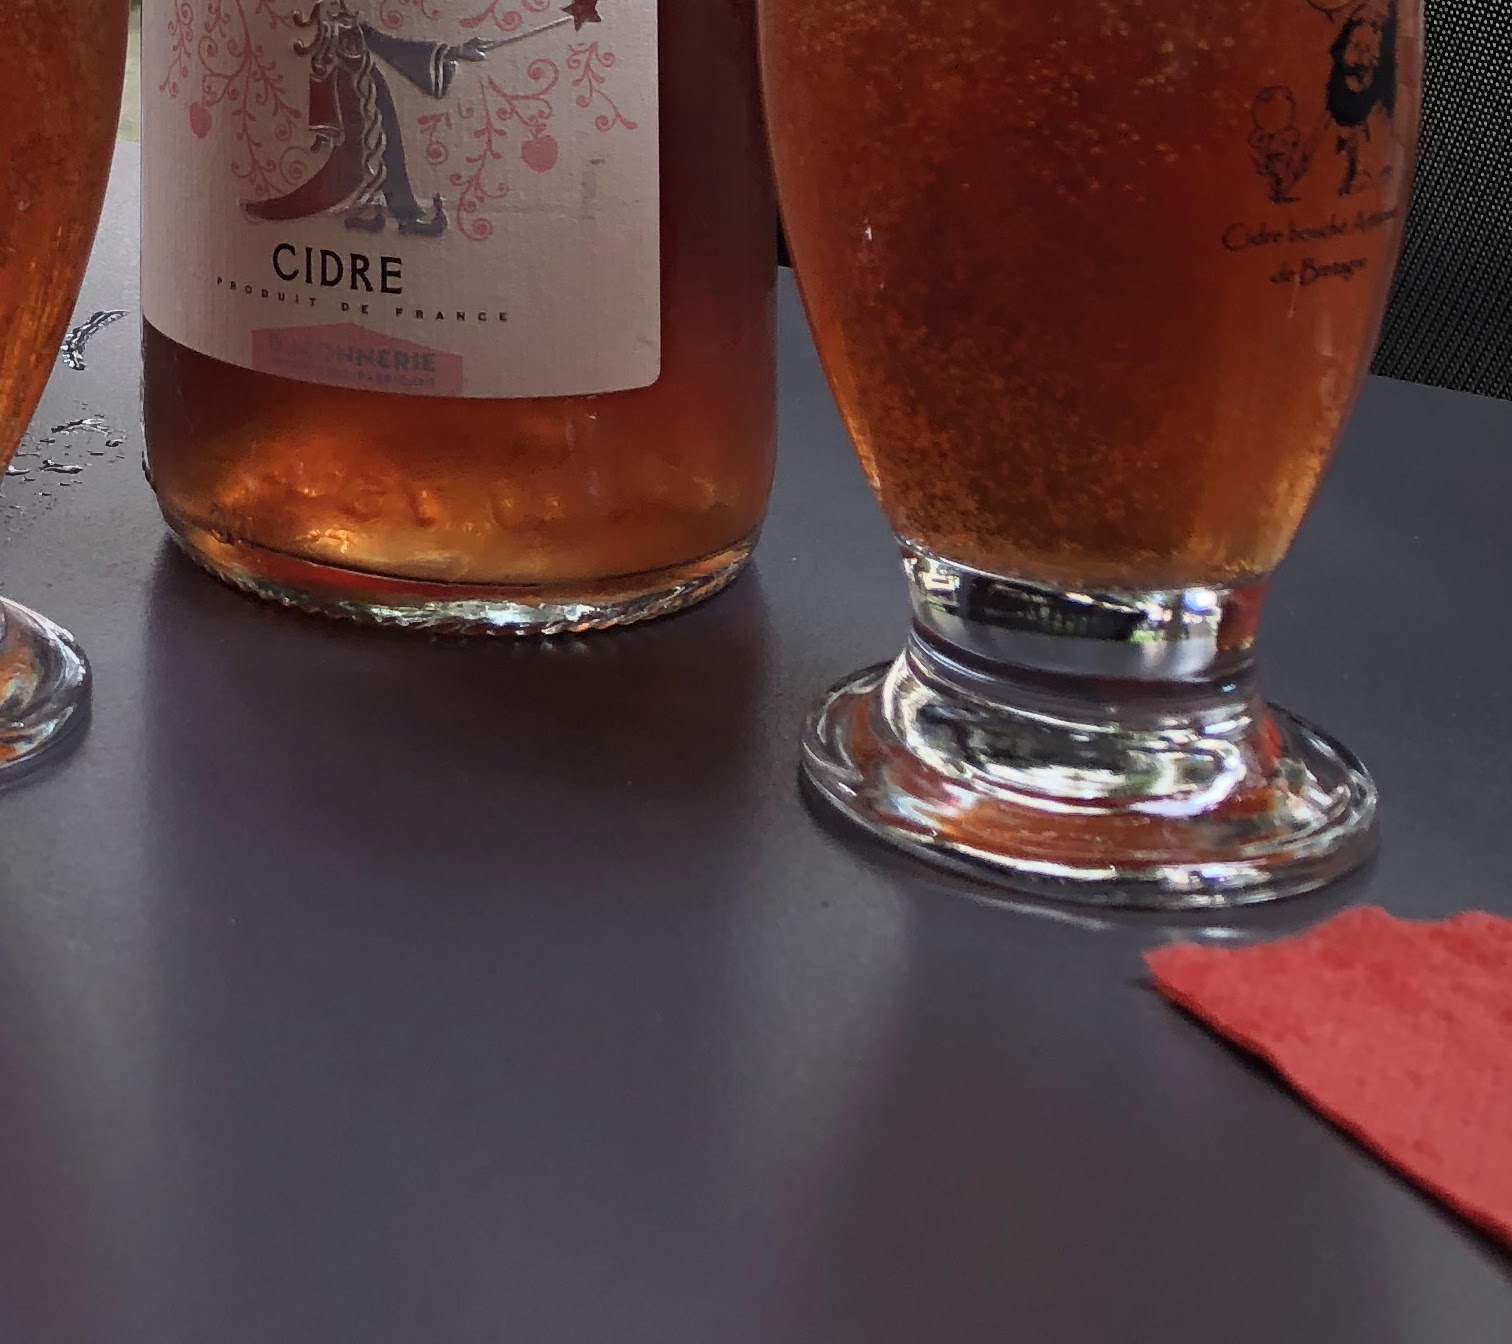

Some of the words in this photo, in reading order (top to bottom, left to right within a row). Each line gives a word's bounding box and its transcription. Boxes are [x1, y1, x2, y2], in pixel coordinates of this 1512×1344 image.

[271, 242, 403, 296] CIDRE
[217, 276, 317, 308] PRODUIT
[340, 302, 369, 315] DE
[395, 307, 508, 322] FRANCE
